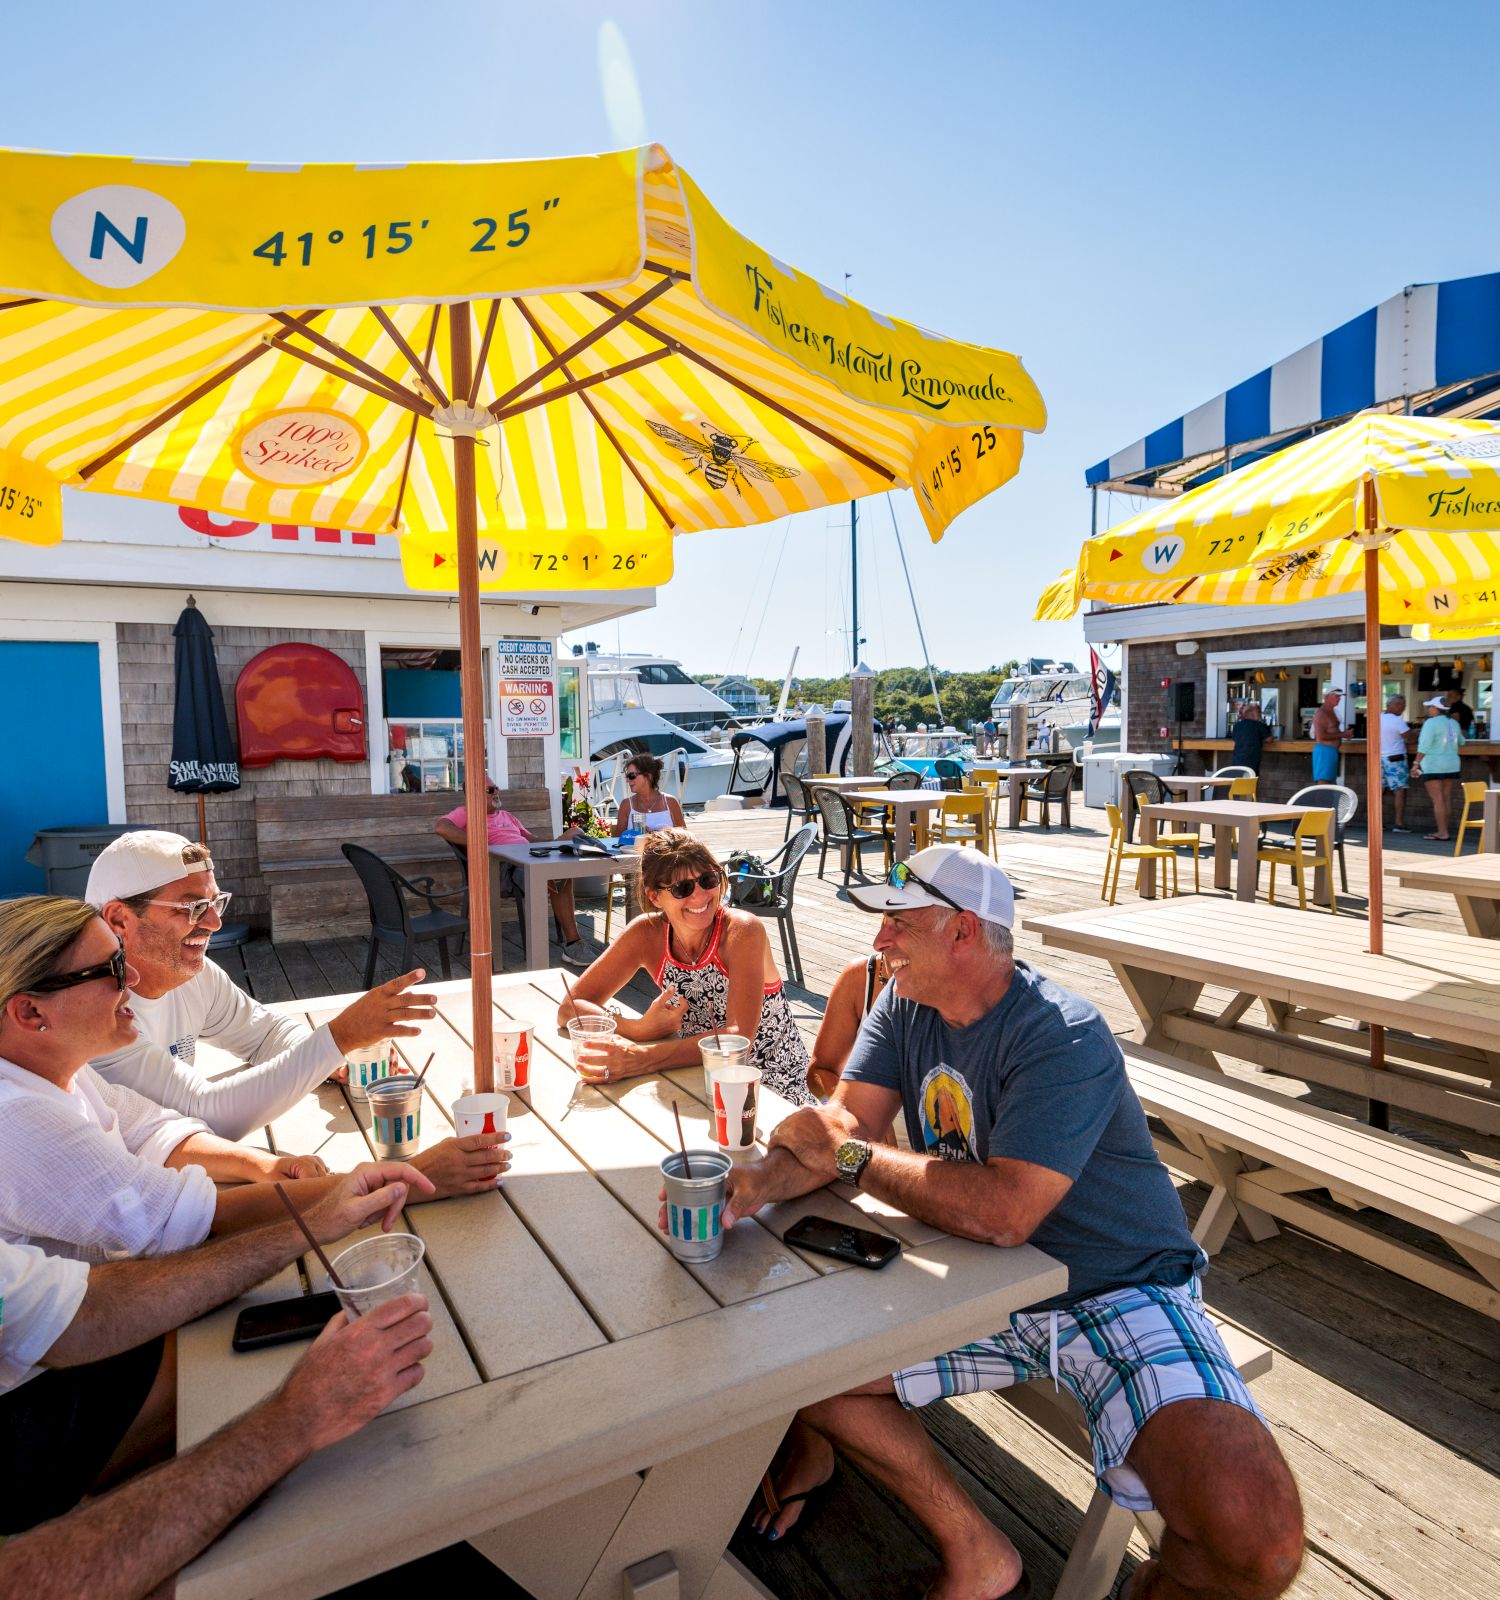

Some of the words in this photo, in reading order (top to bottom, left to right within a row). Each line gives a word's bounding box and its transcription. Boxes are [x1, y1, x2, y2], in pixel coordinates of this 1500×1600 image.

[90, 211, 148, 265] N
[253, 231, 344, 267] 41°
[746, 264, 820, 352] Fishers
[823, 335, 893, 384] Island
[901, 359, 1006, 410] Lemonade
[275, 421, 354, 452] 100%
[245, 439, 354, 473] Spiked
[1155, 544, 1178, 564] W
[1209, 535, 1245, 556] 72°
[533, 554, 569, 571] 72°
[1433, 594, 1449, 609] N
[499, 642, 518, 652] CREDIT
[519, 643, 537, 653] CARDS
[537, 643, 551, 653] ONLY
[504, 655, 513, 664] NO
[514, 655, 539, 665] CHECKS
[539, 655, 549, 665] OR
[502, 665, 518, 674] CASH
[520, 666, 550, 675] ACCEPTED
[504, 683, 548, 694] WARNING
